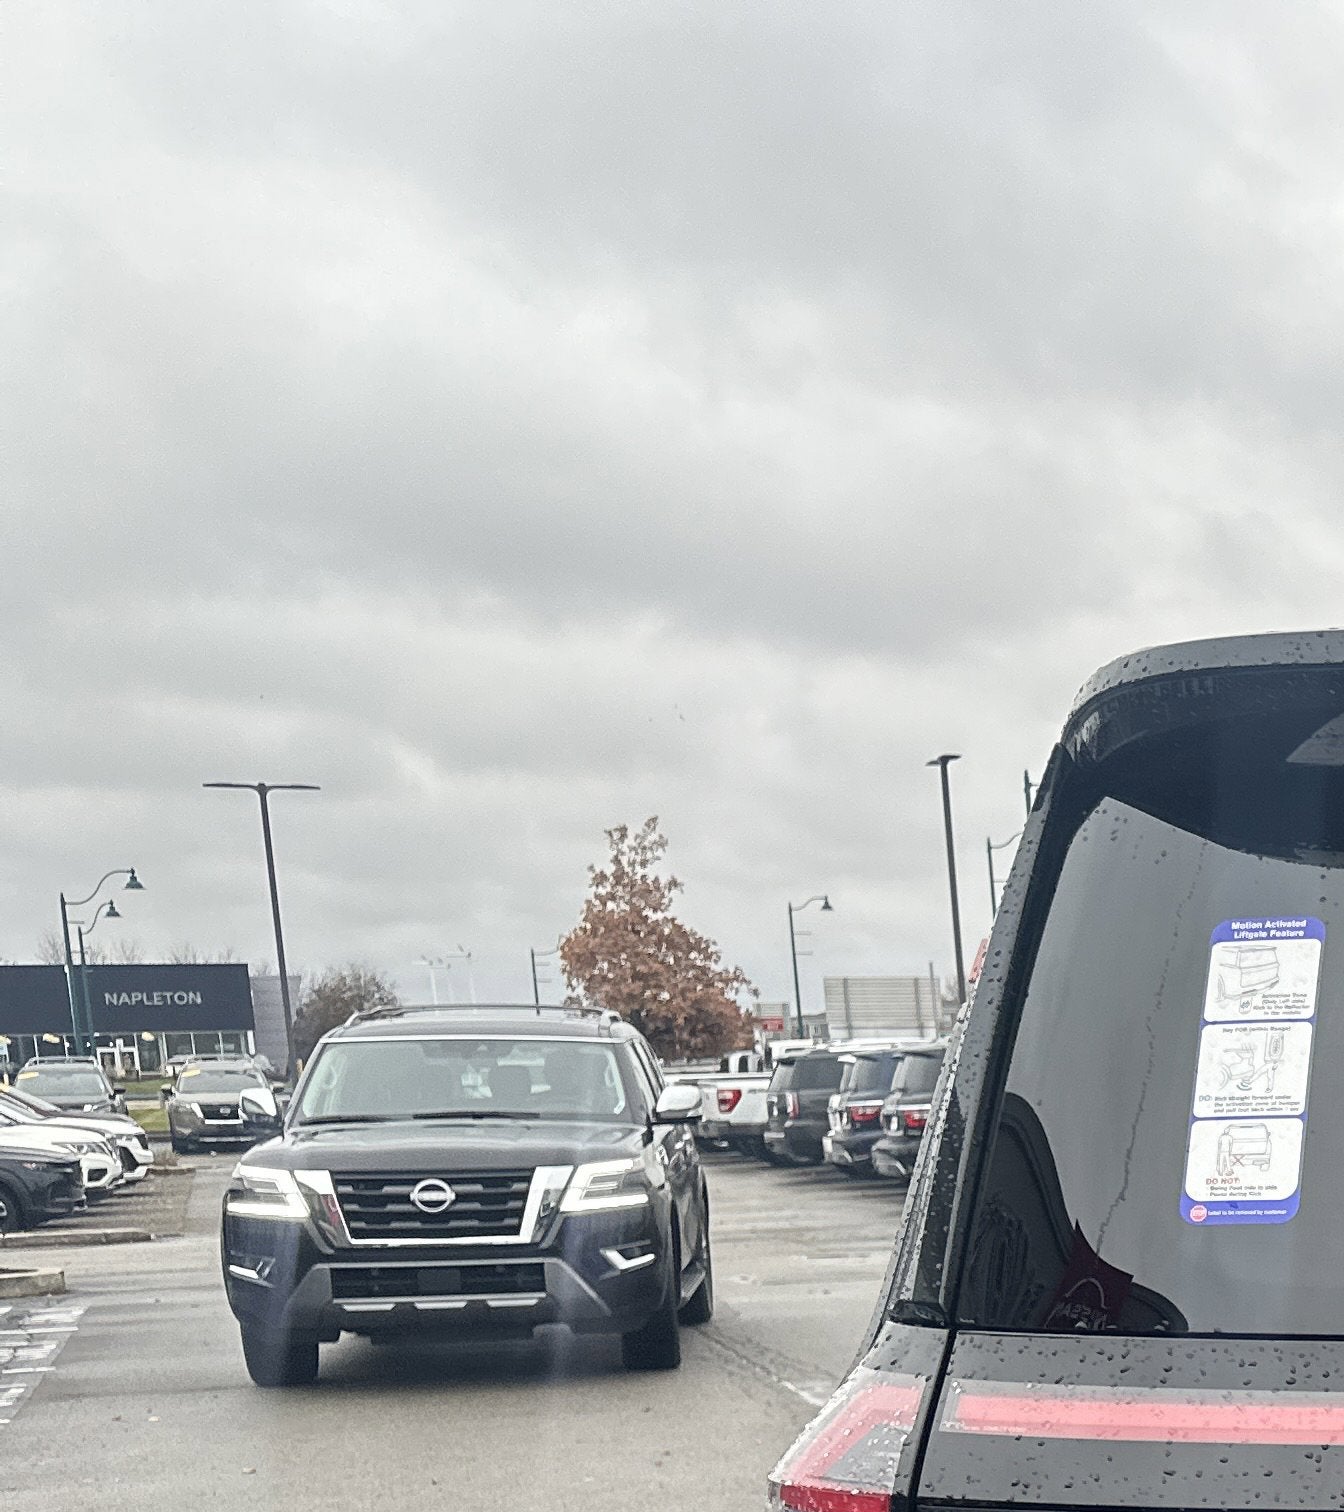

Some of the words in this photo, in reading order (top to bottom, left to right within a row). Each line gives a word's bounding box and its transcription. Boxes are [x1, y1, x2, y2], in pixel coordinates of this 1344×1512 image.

[1231, 921, 1263, 930] Motion
[1264, 919, 1307, 929] Activated
[104, 991, 202, 1006] NAPLETON
